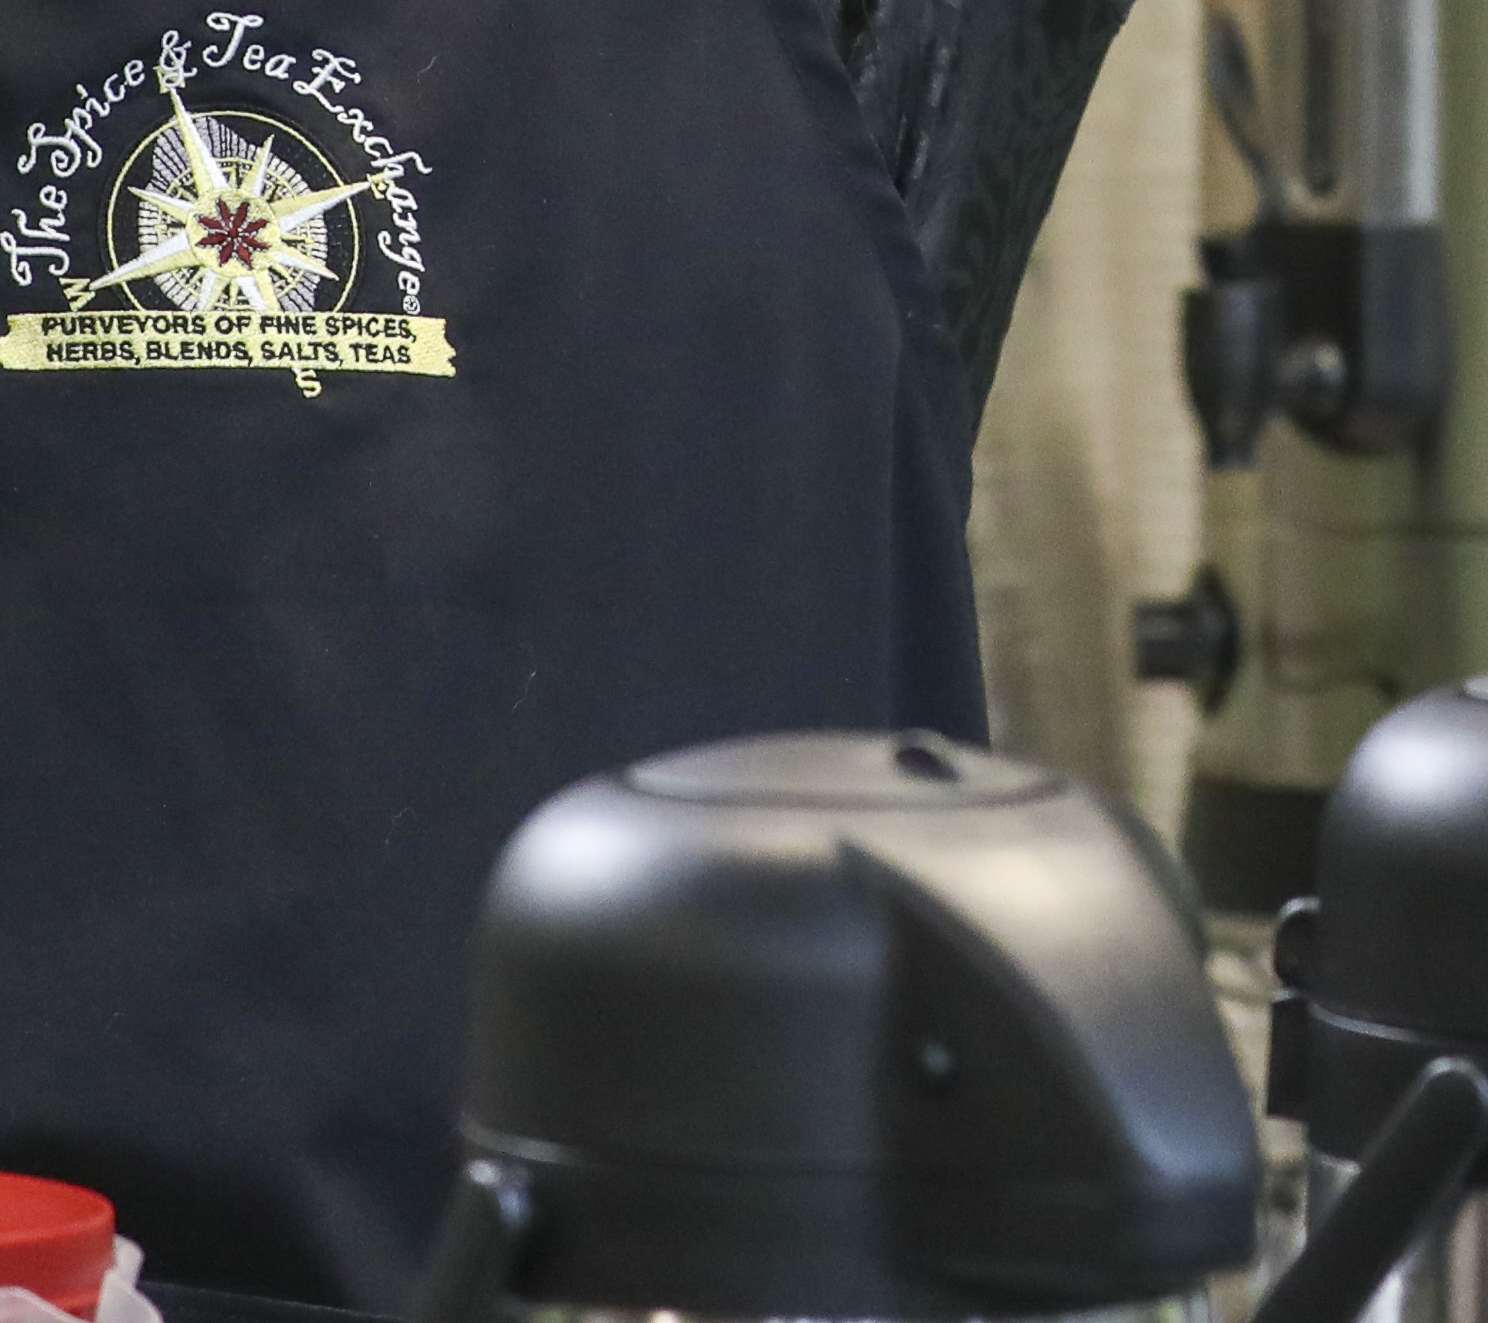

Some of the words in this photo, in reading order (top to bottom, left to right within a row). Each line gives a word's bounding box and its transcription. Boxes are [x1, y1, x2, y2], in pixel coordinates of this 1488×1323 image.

[158, 29, 198, 88] &
[202, 11, 297, 80] Tea
[16, 59, 146, 178] Spice
[0, 184, 70, 287] The
[41, 315, 207, 337] PURVEYORS
[214, 315, 250, 335] OF
[259, 315, 318, 336] FINE
[324, 316, 417, 343] SPICES,
[46, 341, 140, 366] HERBS,
[146, 340, 252, 366] BLENDS,
[260, 341, 344, 367] SALTS,
[349, 342, 411, 364] TEAS
